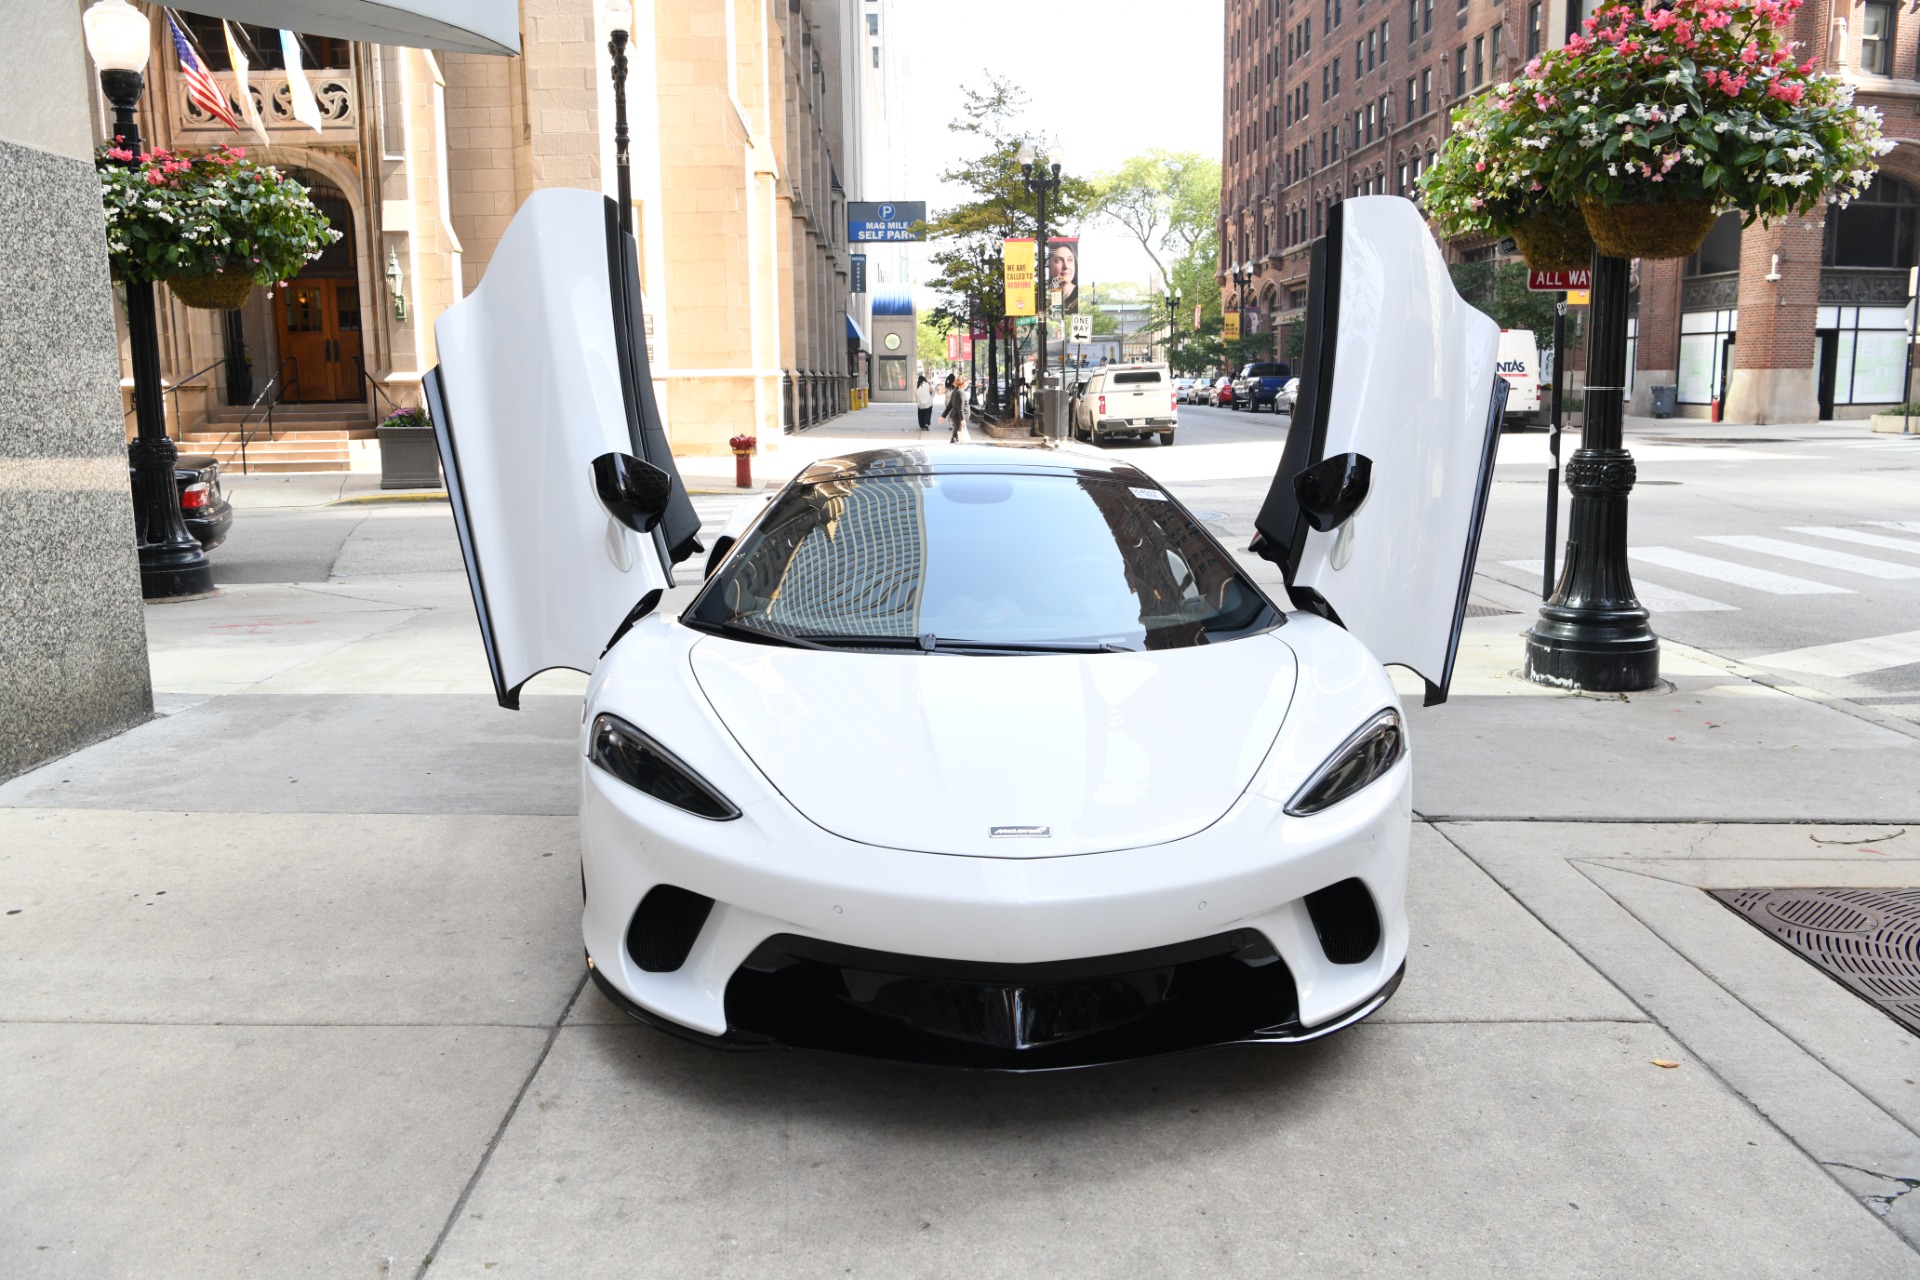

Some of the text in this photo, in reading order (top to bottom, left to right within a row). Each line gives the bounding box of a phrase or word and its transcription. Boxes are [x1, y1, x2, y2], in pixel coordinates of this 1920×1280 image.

[882, 206, 892, 218] P
[866, 222, 908, 230] MAG MILE
[858, 230, 884, 240] SELF
[1536, 271, 1562, 285] ALL
[1496, 360, 1526, 372] NTAS
